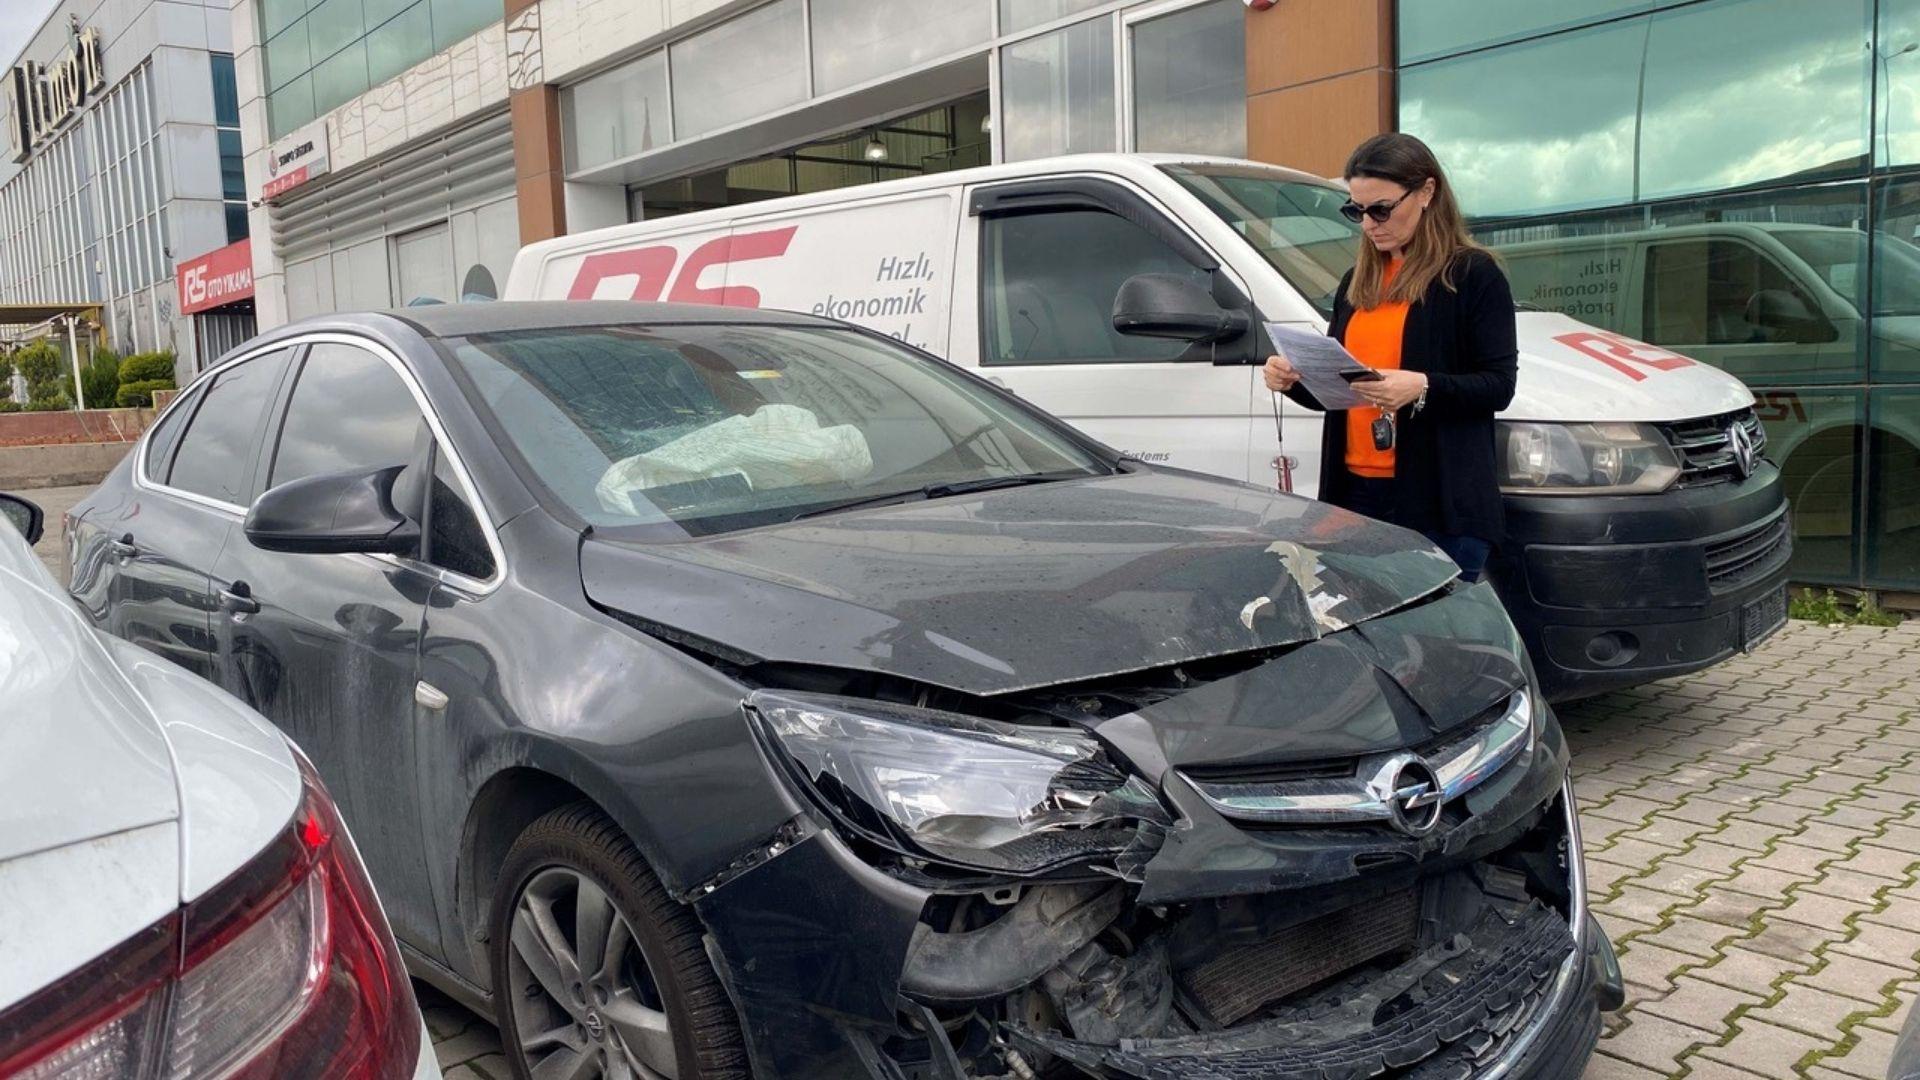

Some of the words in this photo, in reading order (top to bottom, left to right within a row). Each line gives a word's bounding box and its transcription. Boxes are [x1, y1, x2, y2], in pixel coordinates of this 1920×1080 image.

[876, 252, 934, 281] Hızlı,
[184, 264, 208, 307] RS
[208, 278, 222, 298] OTO
[224, 268, 252, 293] YIKAMA
[812, 287, 927, 319] ekonomik
